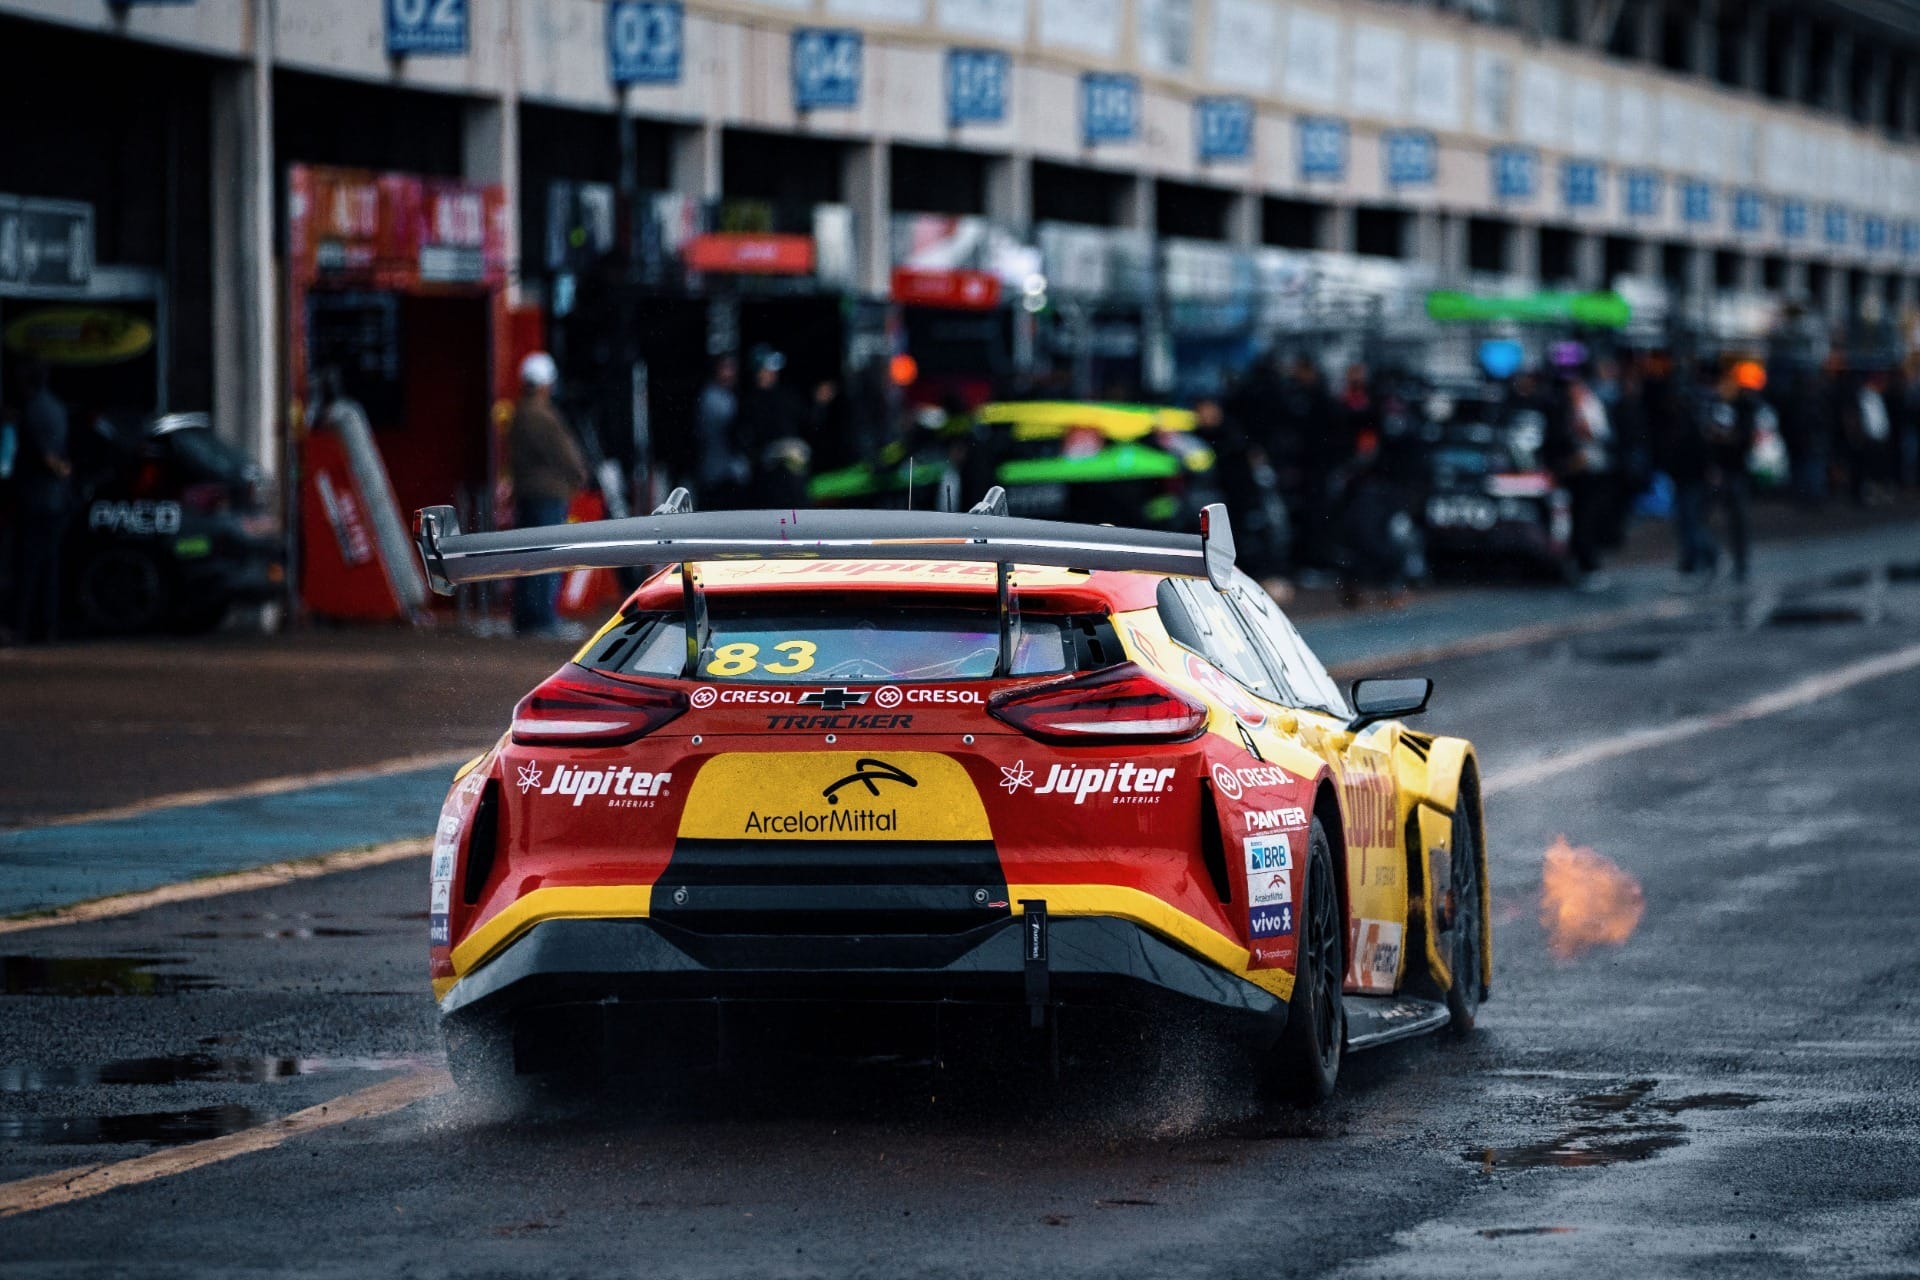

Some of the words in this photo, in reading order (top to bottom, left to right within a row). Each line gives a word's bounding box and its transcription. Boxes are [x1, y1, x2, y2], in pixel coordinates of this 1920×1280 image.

[706, 640, 817, 676] 83
[720, 690, 795, 704] CRESOL
[906, 689, 984, 704] CRESOL
[766, 714, 914, 730] TRACKER
[1236, 766, 1295, 788] CRESOL
[608, 799, 656, 808] BATERIAS
[1113, 796, 1161, 804] BATERIAS
[745, 809, 897, 833] ArcelorMittal
[1244, 806, 1308, 831] PANTER
[1264, 845, 1287, 869] BRB
[1252, 911, 1281, 933] vivo
